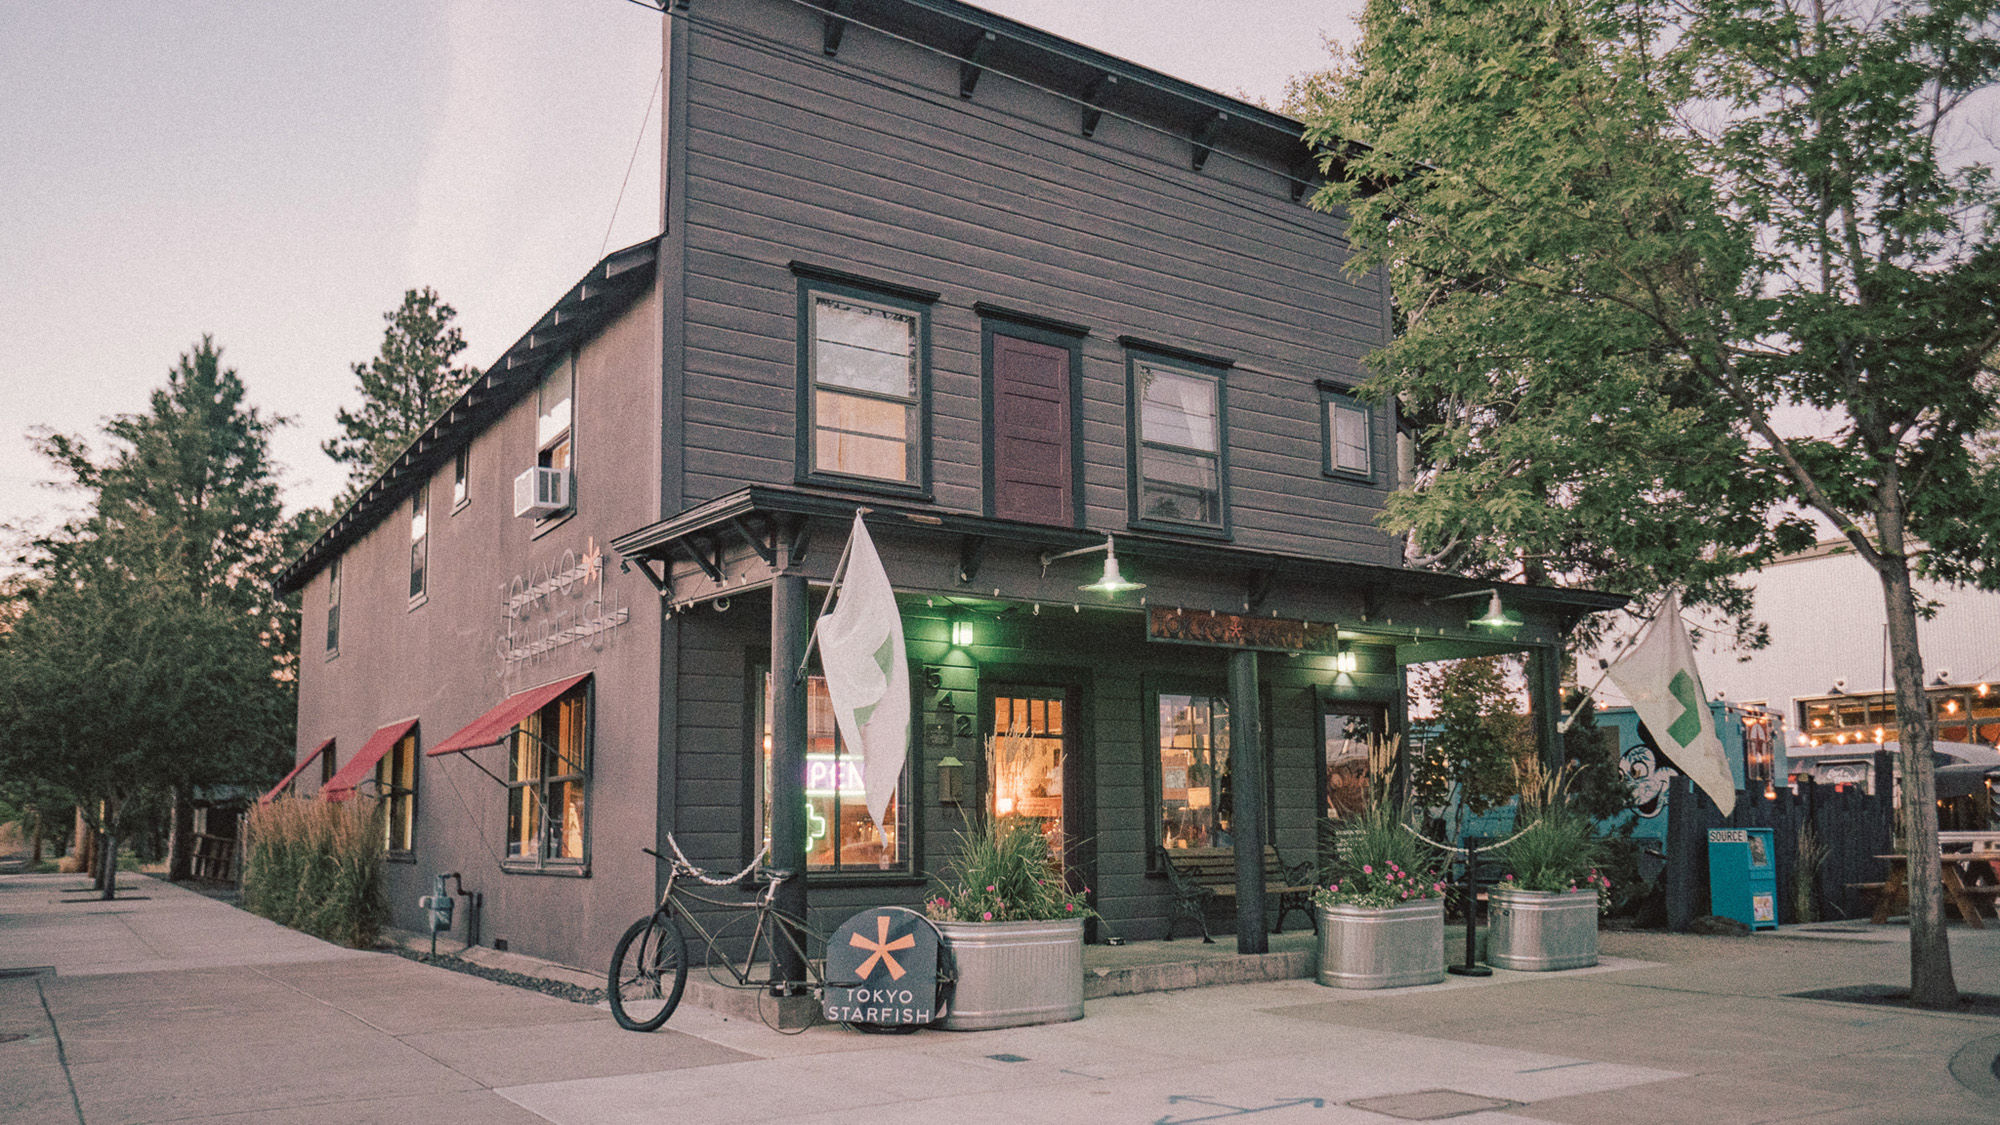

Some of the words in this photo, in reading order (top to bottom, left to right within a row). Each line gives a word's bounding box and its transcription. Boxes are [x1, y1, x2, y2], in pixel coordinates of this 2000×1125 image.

[498, 548, 576, 622] TOKYO
[1710, 831, 1743, 841] SOURCE
[847, 989, 912, 1003] TOKYO
[828, 1006, 929, 1022] STARFISH
